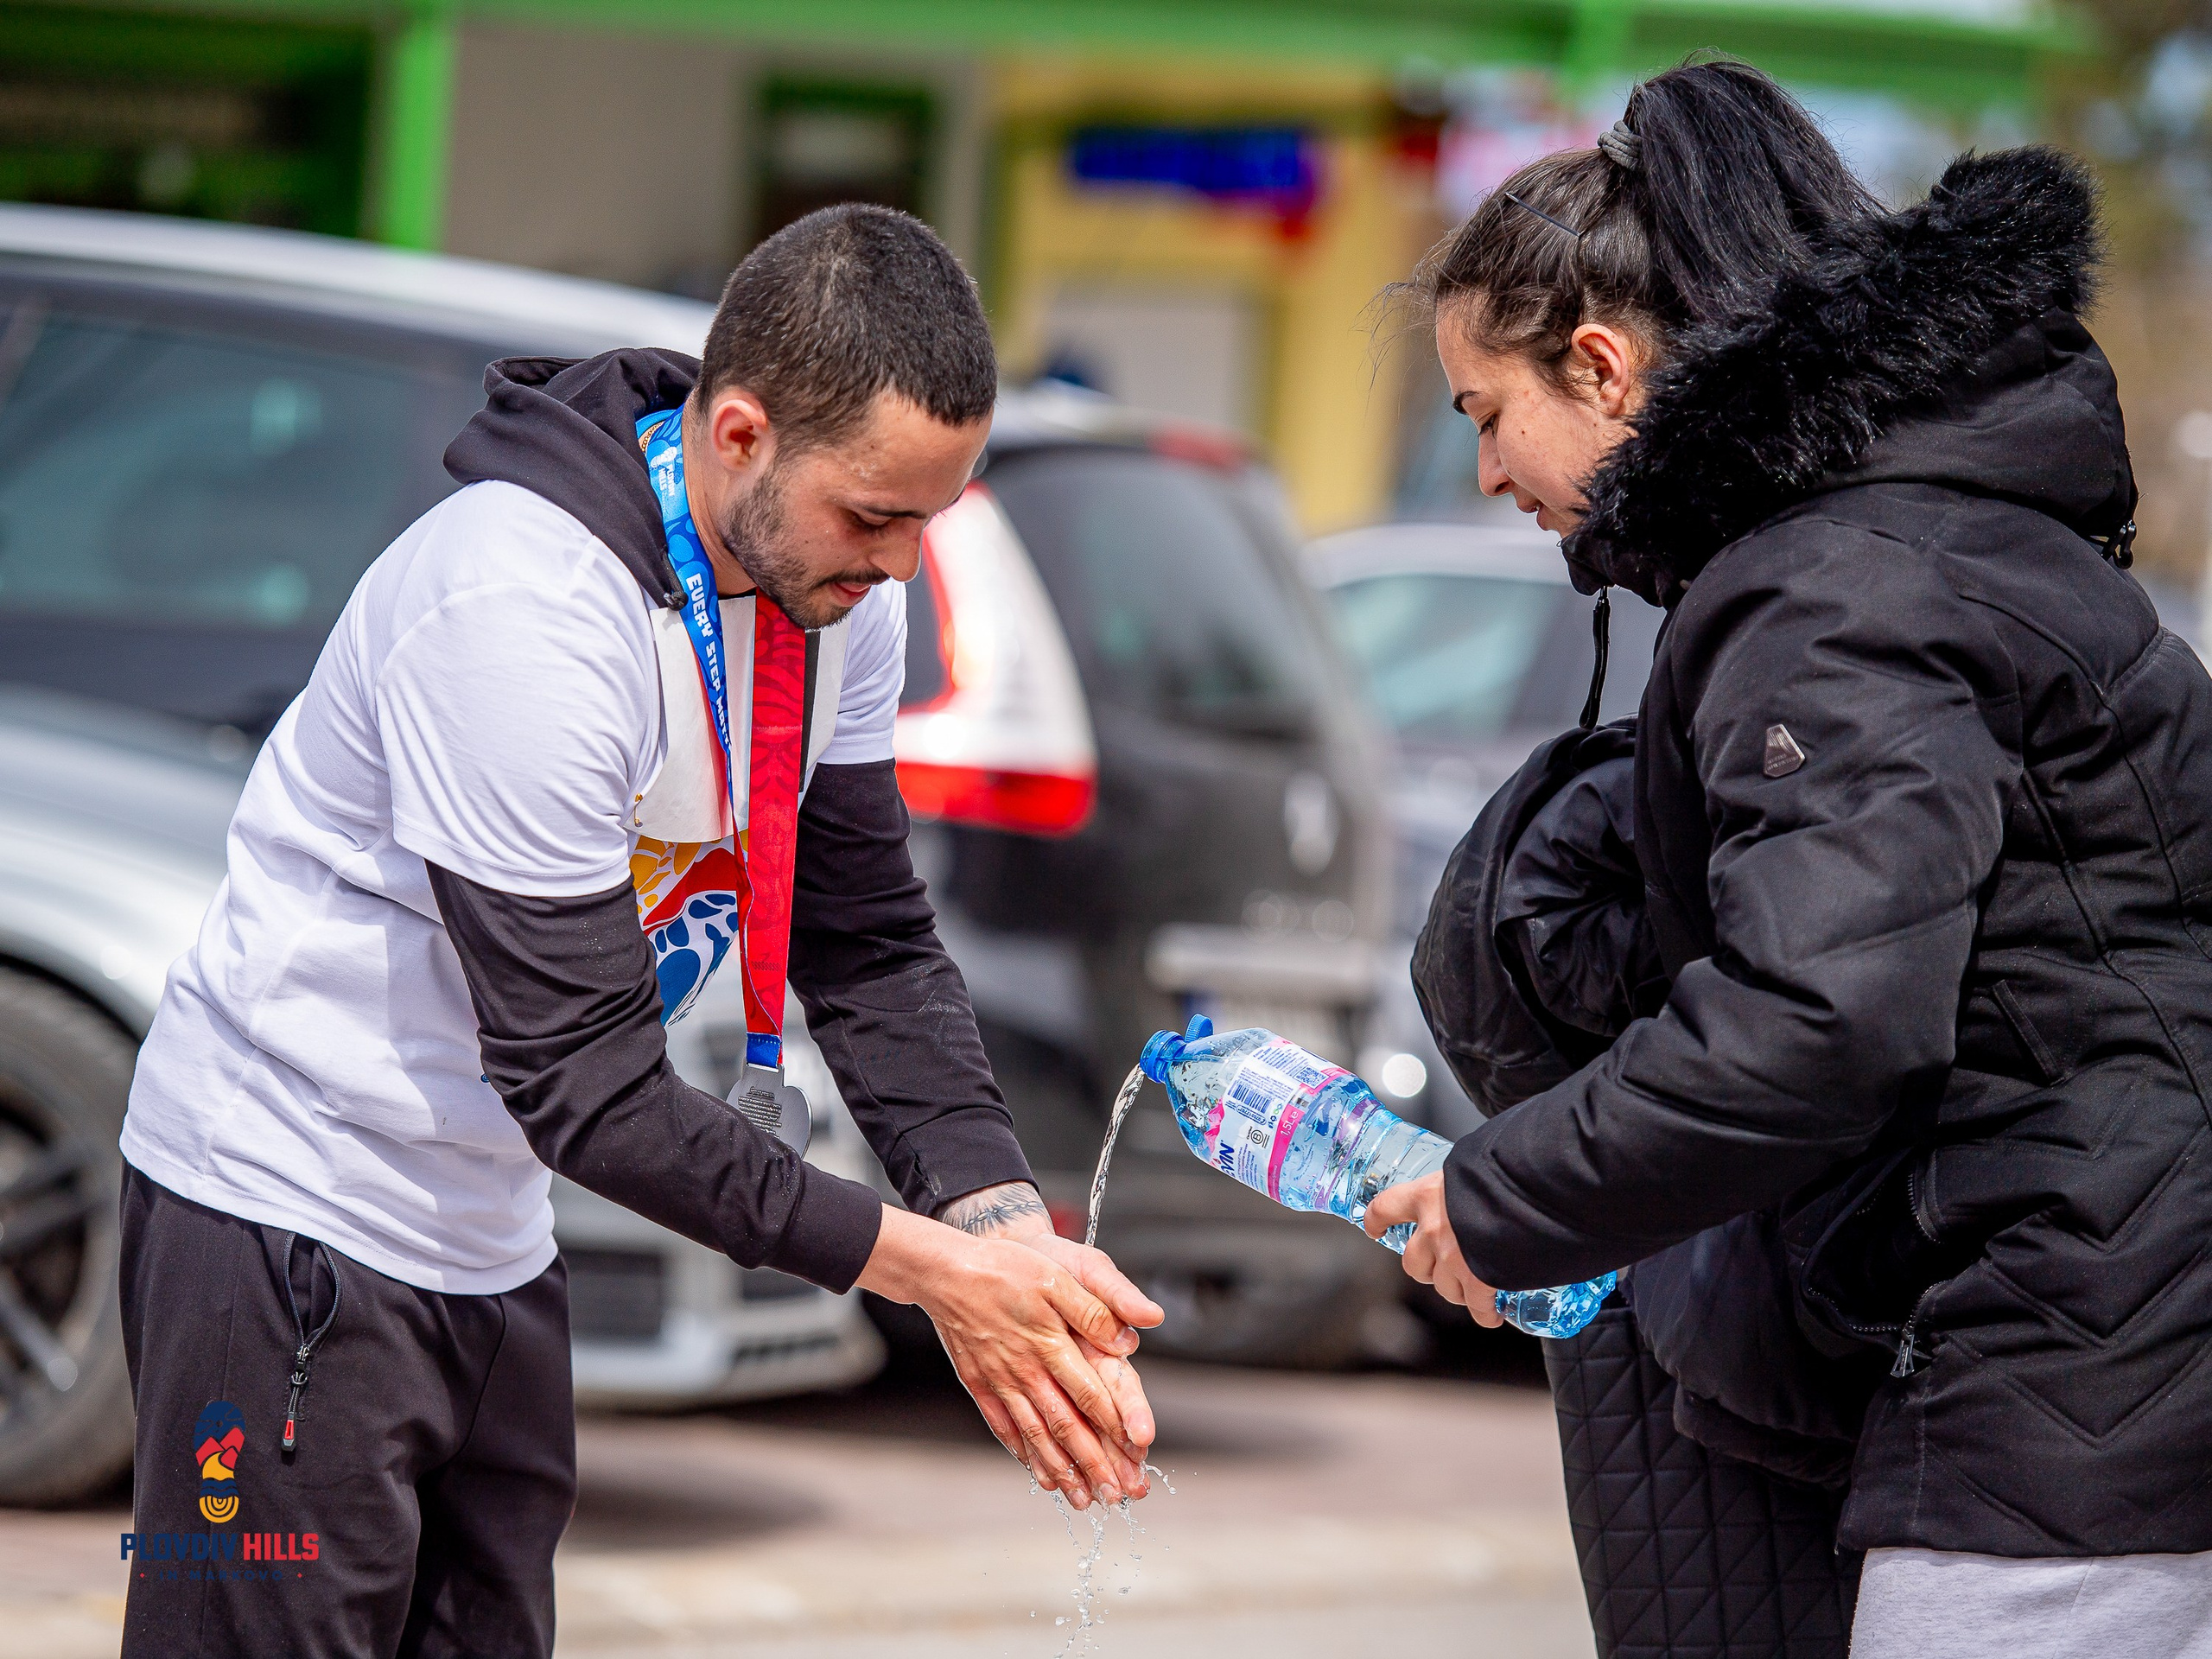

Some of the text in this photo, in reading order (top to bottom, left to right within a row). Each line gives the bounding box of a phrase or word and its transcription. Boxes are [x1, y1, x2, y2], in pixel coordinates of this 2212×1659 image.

[658, 467, 667, 491] HILLS
[685, 572, 714, 639] EVERY
[705, 640, 721, 692] STEP
